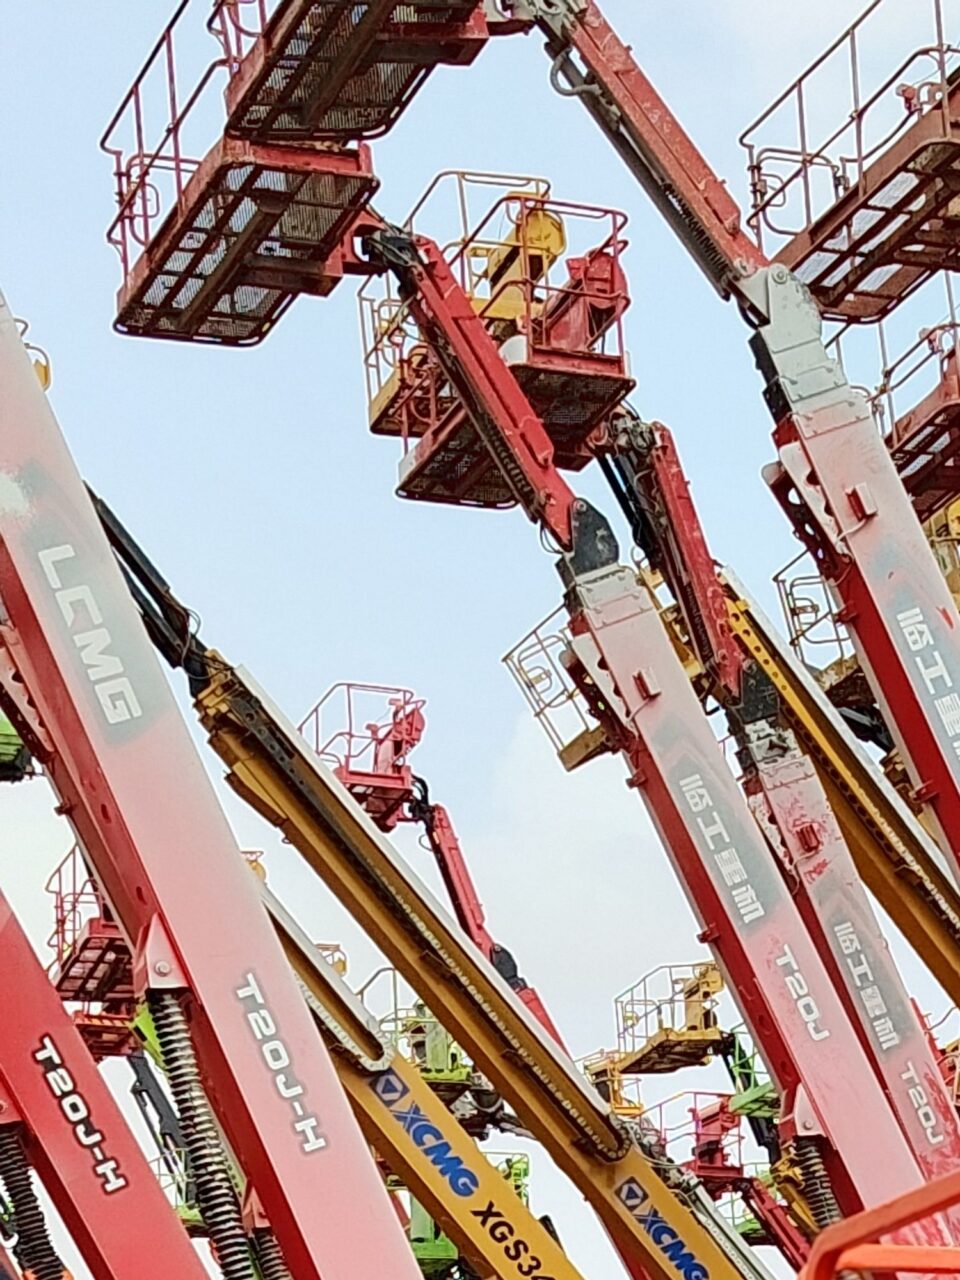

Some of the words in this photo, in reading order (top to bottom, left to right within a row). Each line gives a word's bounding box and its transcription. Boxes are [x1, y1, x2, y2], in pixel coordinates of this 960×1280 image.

[679, 774, 764, 923] 临工重机
[776, 944, 831, 1041] T20J
[834, 922, 899, 1050] 临工重机
[34, 1036, 126, 1193] T20J-H
[235, 972, 327, 1153] T20J-H
[900, 1061, 944, 1145] T20J
[392, 1102, 480, 1198] XCMG
